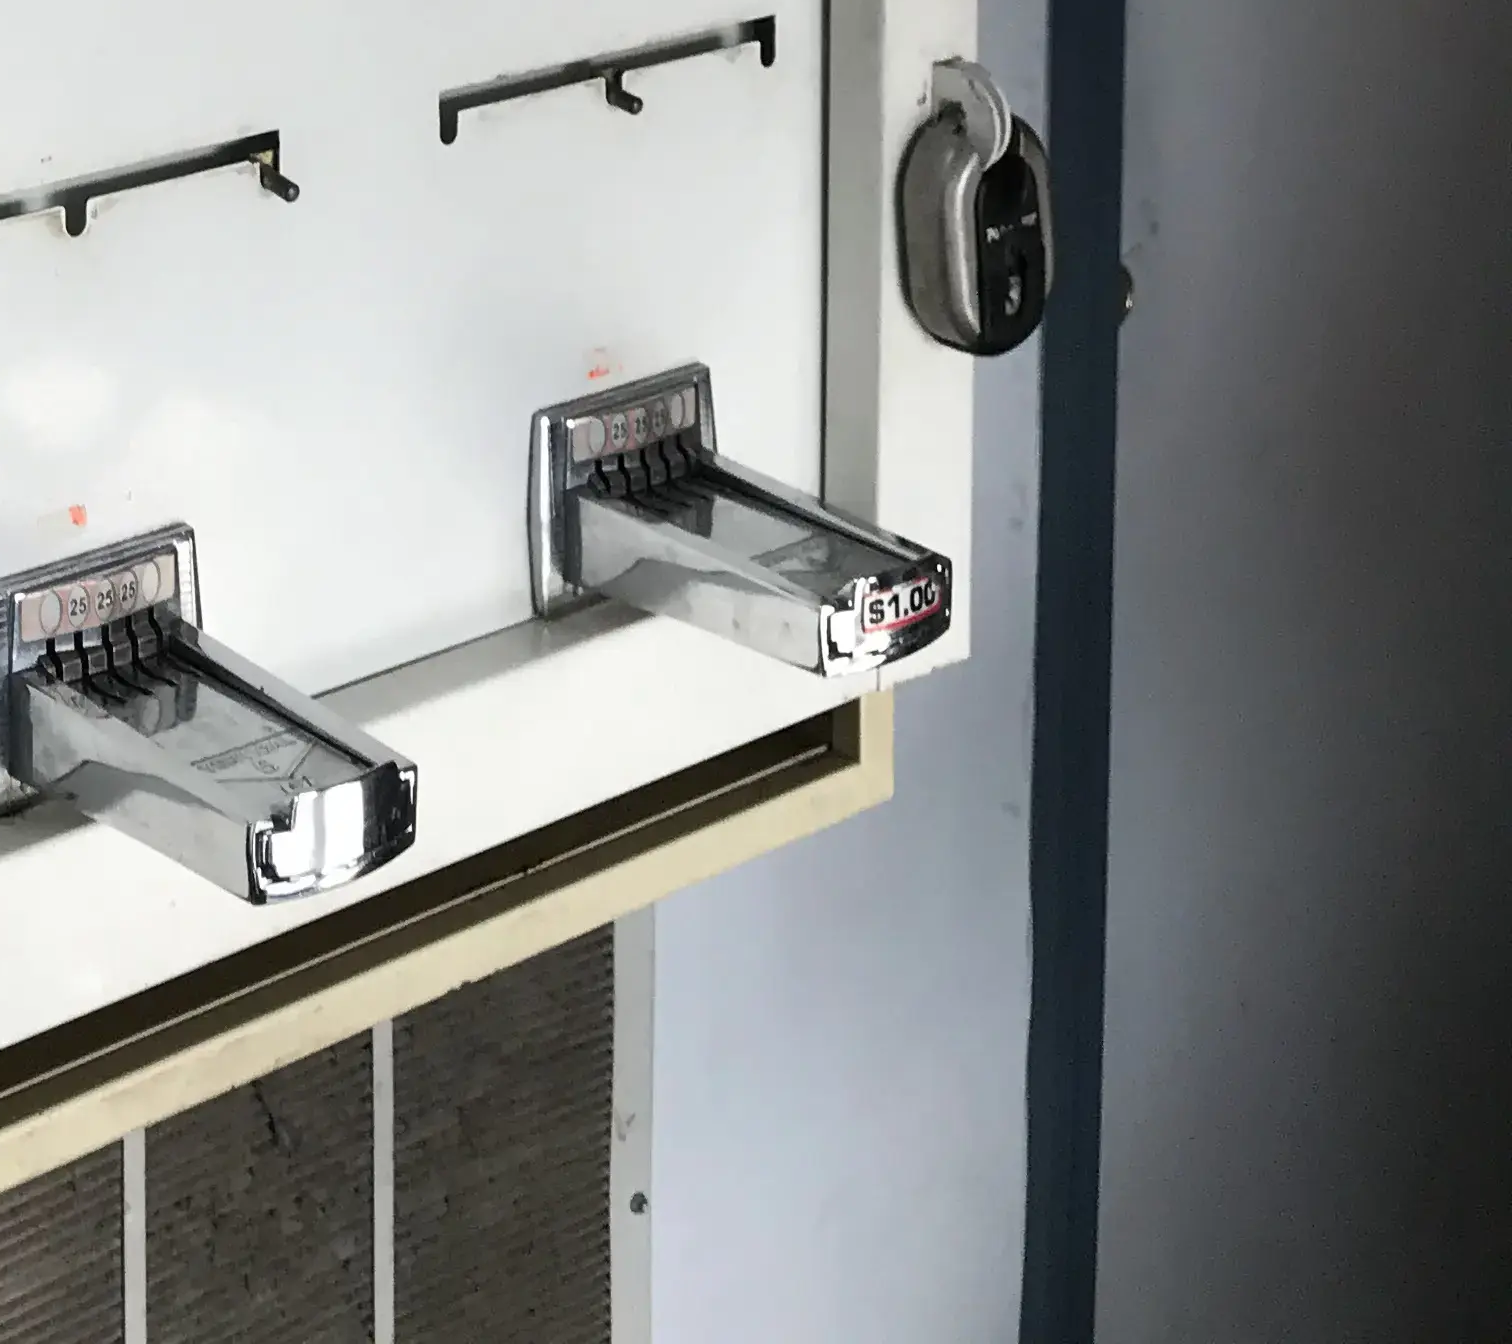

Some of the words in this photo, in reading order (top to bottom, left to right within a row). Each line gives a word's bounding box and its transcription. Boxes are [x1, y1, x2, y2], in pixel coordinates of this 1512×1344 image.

[70, 596, 87, 616] 25
[97, 589, 113, 610] 25
[121, 581, 136, 602] 25
[868, 579, 936, 624] $1.00
